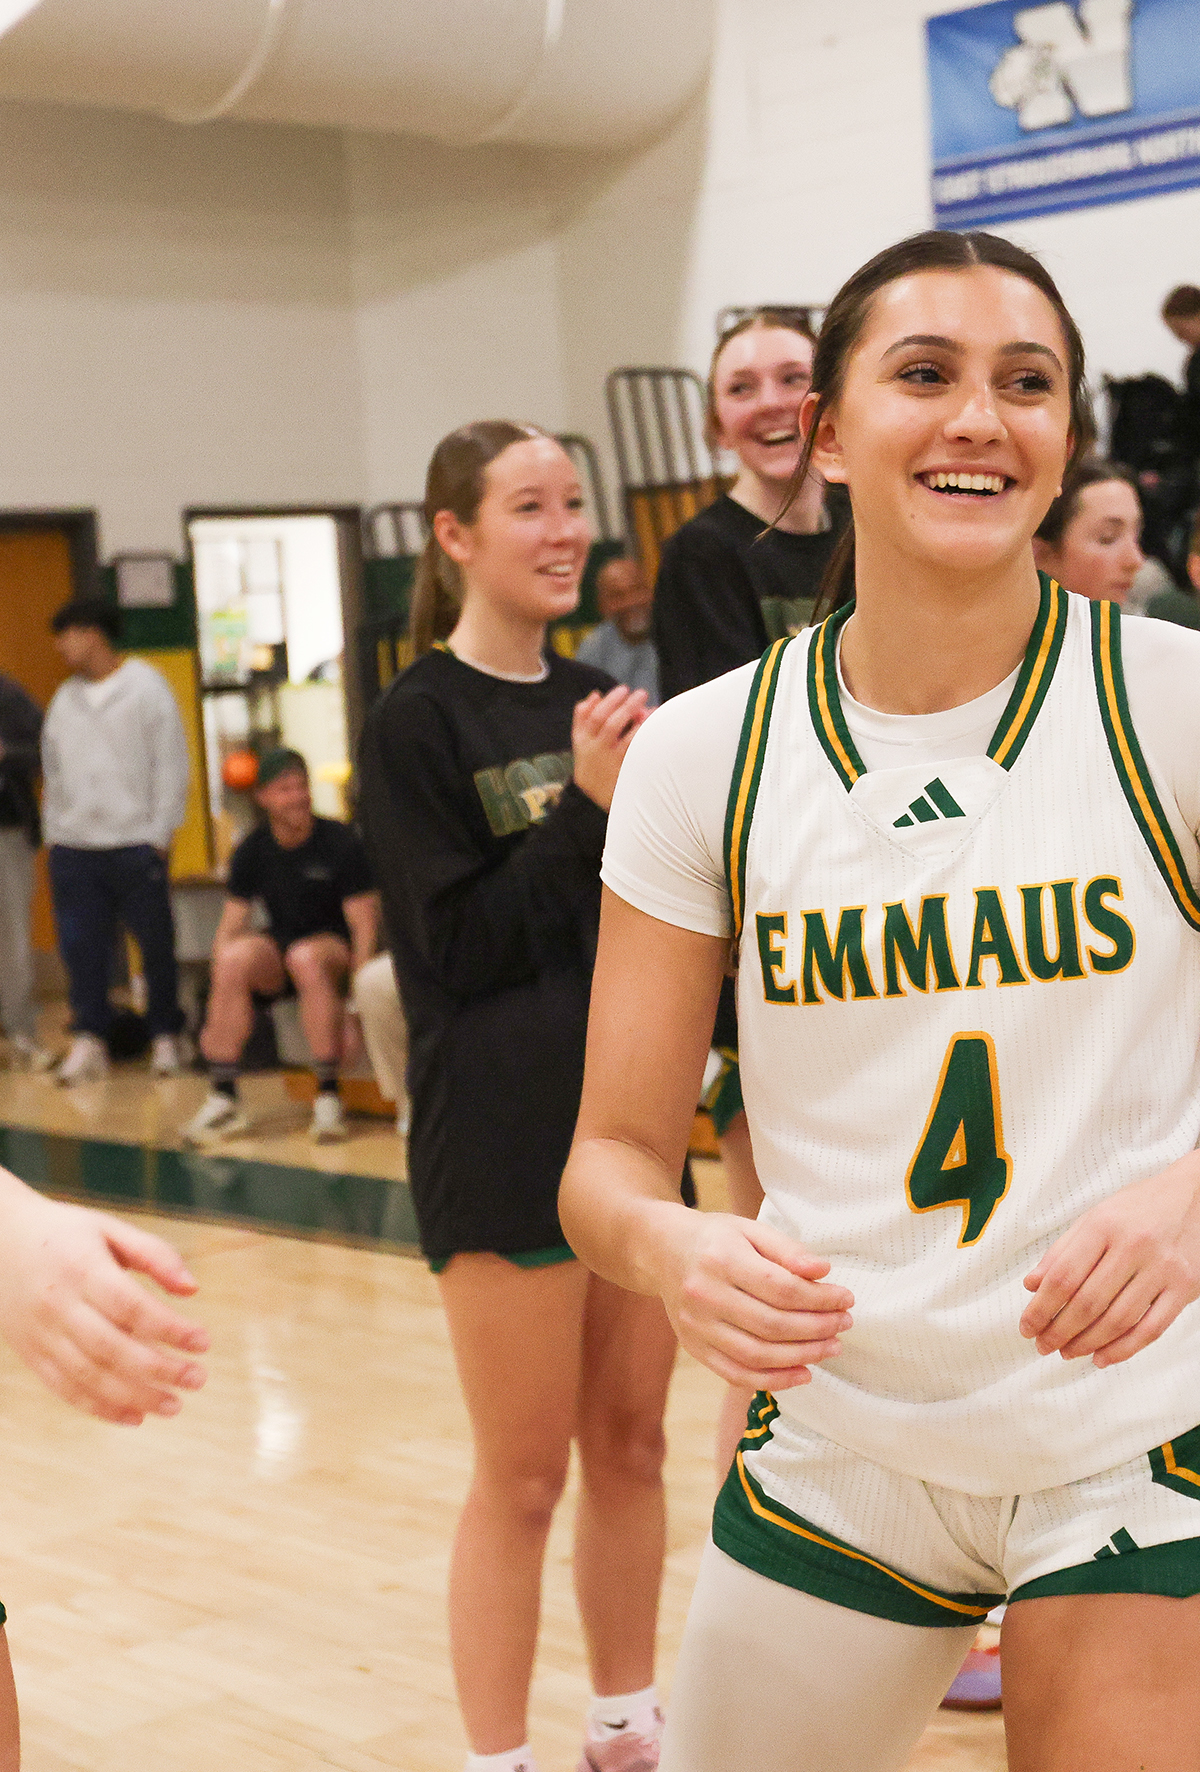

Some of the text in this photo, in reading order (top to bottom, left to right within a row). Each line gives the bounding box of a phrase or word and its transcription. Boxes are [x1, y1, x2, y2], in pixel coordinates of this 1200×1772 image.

[1013, 0, 1133, 131] N
[936, 169, 980, 201] EAST
[756, 875, 1137, 1006] EMMAUS
[904, 1031, 1014, 1248] 4
